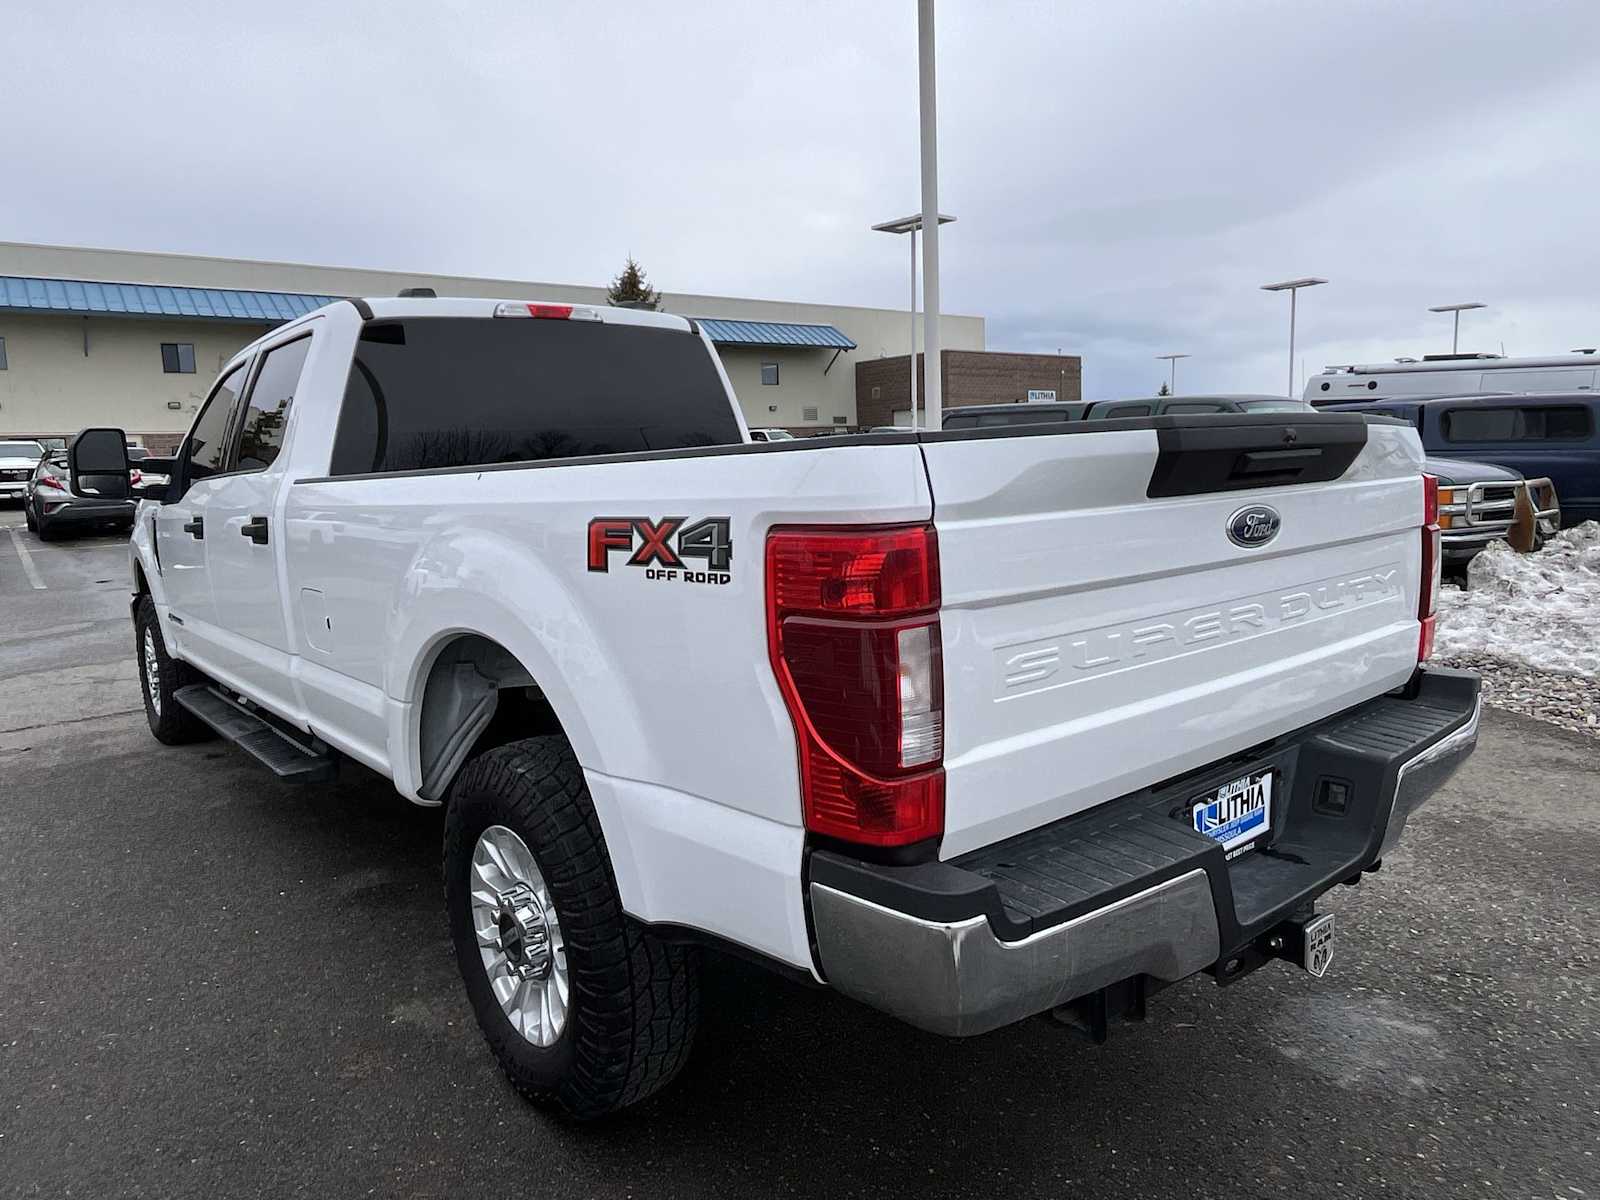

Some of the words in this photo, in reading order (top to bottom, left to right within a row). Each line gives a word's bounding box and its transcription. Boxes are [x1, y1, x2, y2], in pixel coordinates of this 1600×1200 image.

[1034, 391, 1055, 400] LITHIA
[1244, 513, 1273, 538] Ford
[587, 516, 733, 573] FX4
[645, 569, 678, 581] OFF
[683, 571, 731, 585] ROAD
[1006, 602, 1264, 688] SUPER
[1280, 569, 1397, 622] DUTY
[1219, 783, 1265, 826] LITHIA
[1310, 932, 1331, 952] RAM
